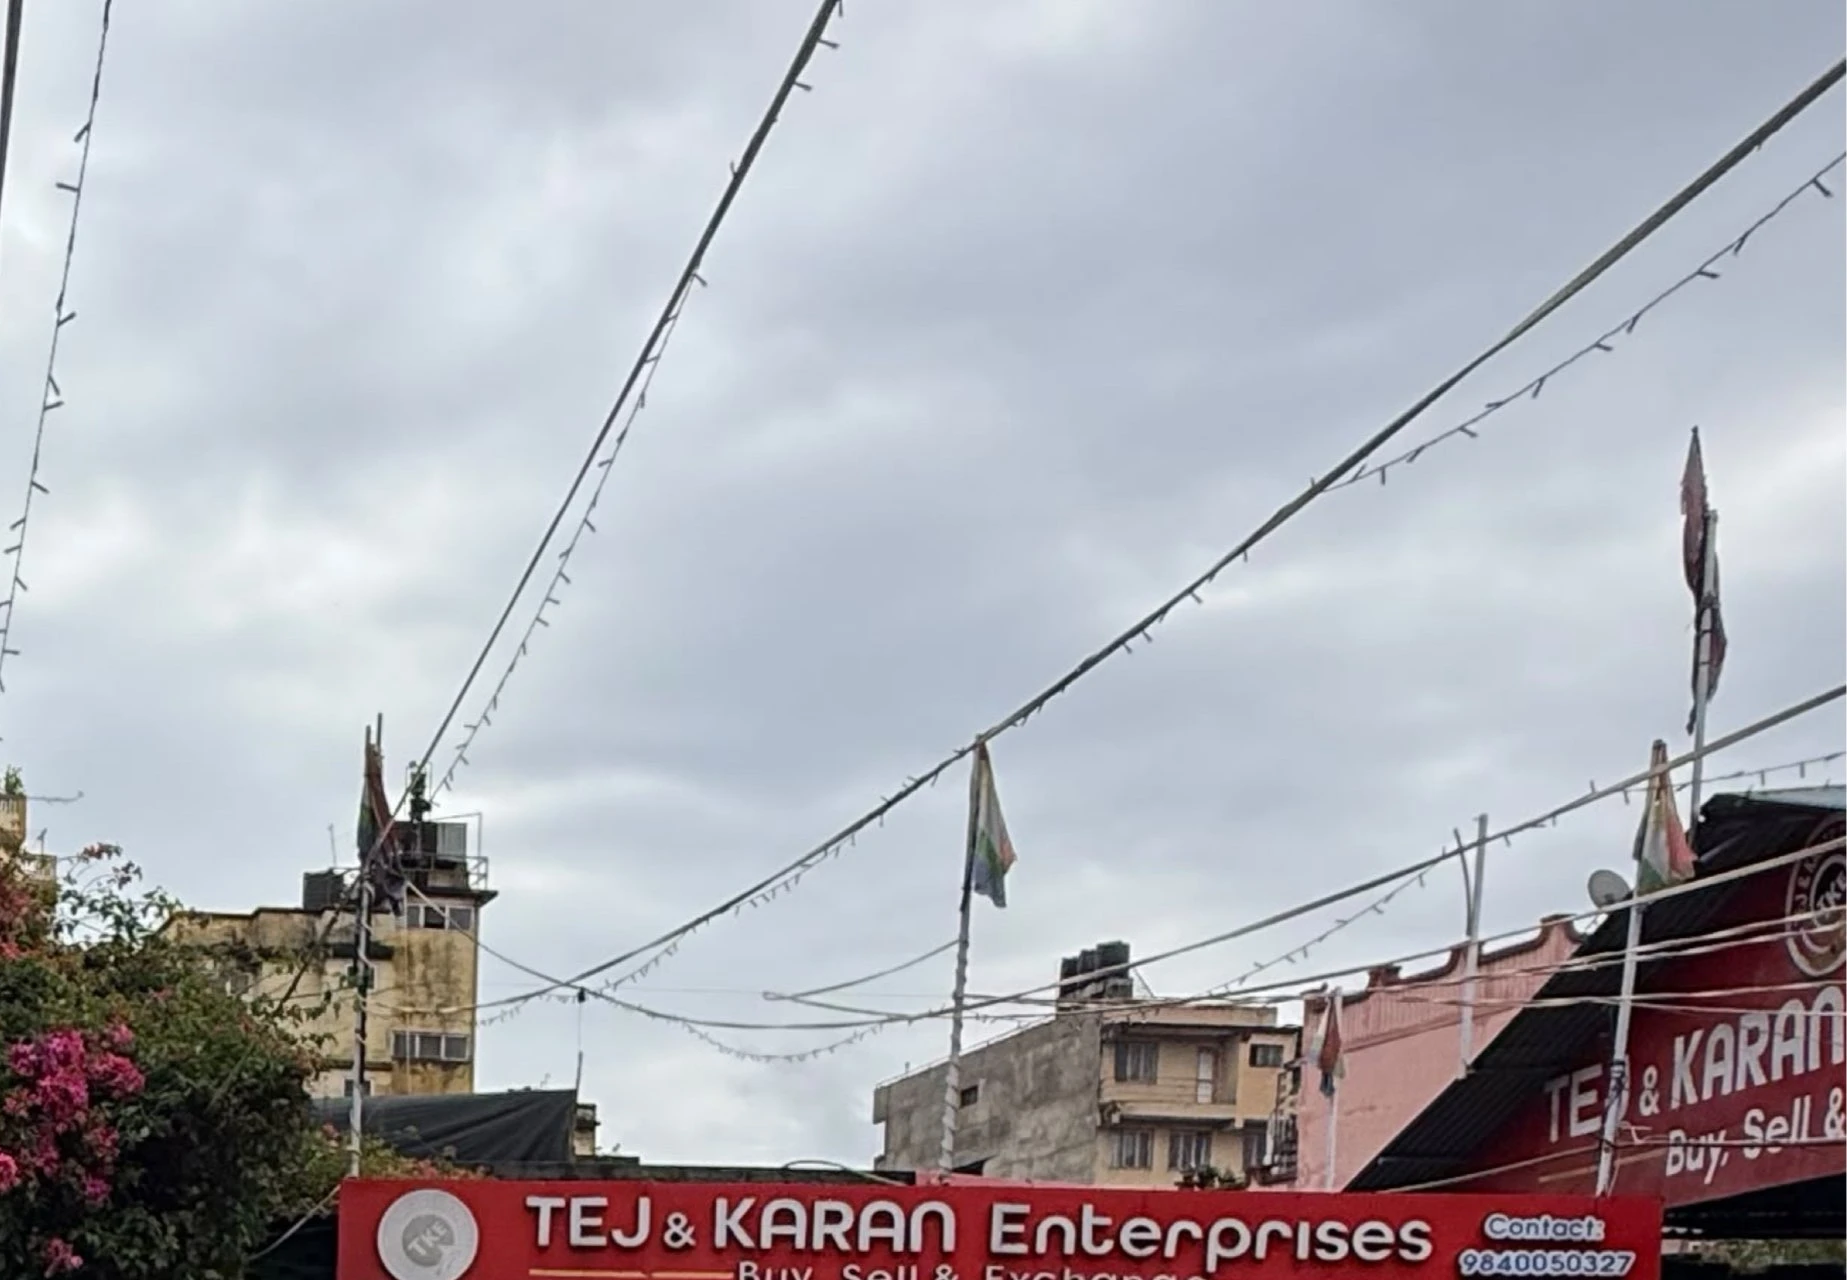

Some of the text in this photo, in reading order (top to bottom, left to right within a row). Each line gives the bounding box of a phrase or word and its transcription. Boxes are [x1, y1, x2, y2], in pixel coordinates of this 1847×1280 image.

[1639, 1065, 1660, 1116] &
[1670, 986, 1845, 1109] KARAN
[1665, 1128, 1728, 1184] Buy,
[1743, 1094, 1811, 1159] Sell
[407, 1218, 449, 1258] TKE
[525, 1196, 1433, 1274] TEJ & KARAN Enterprises
[1486, 1214, 1604, 1240] Contact:
[1461, 1251, 1634, 1275] 9840050327
